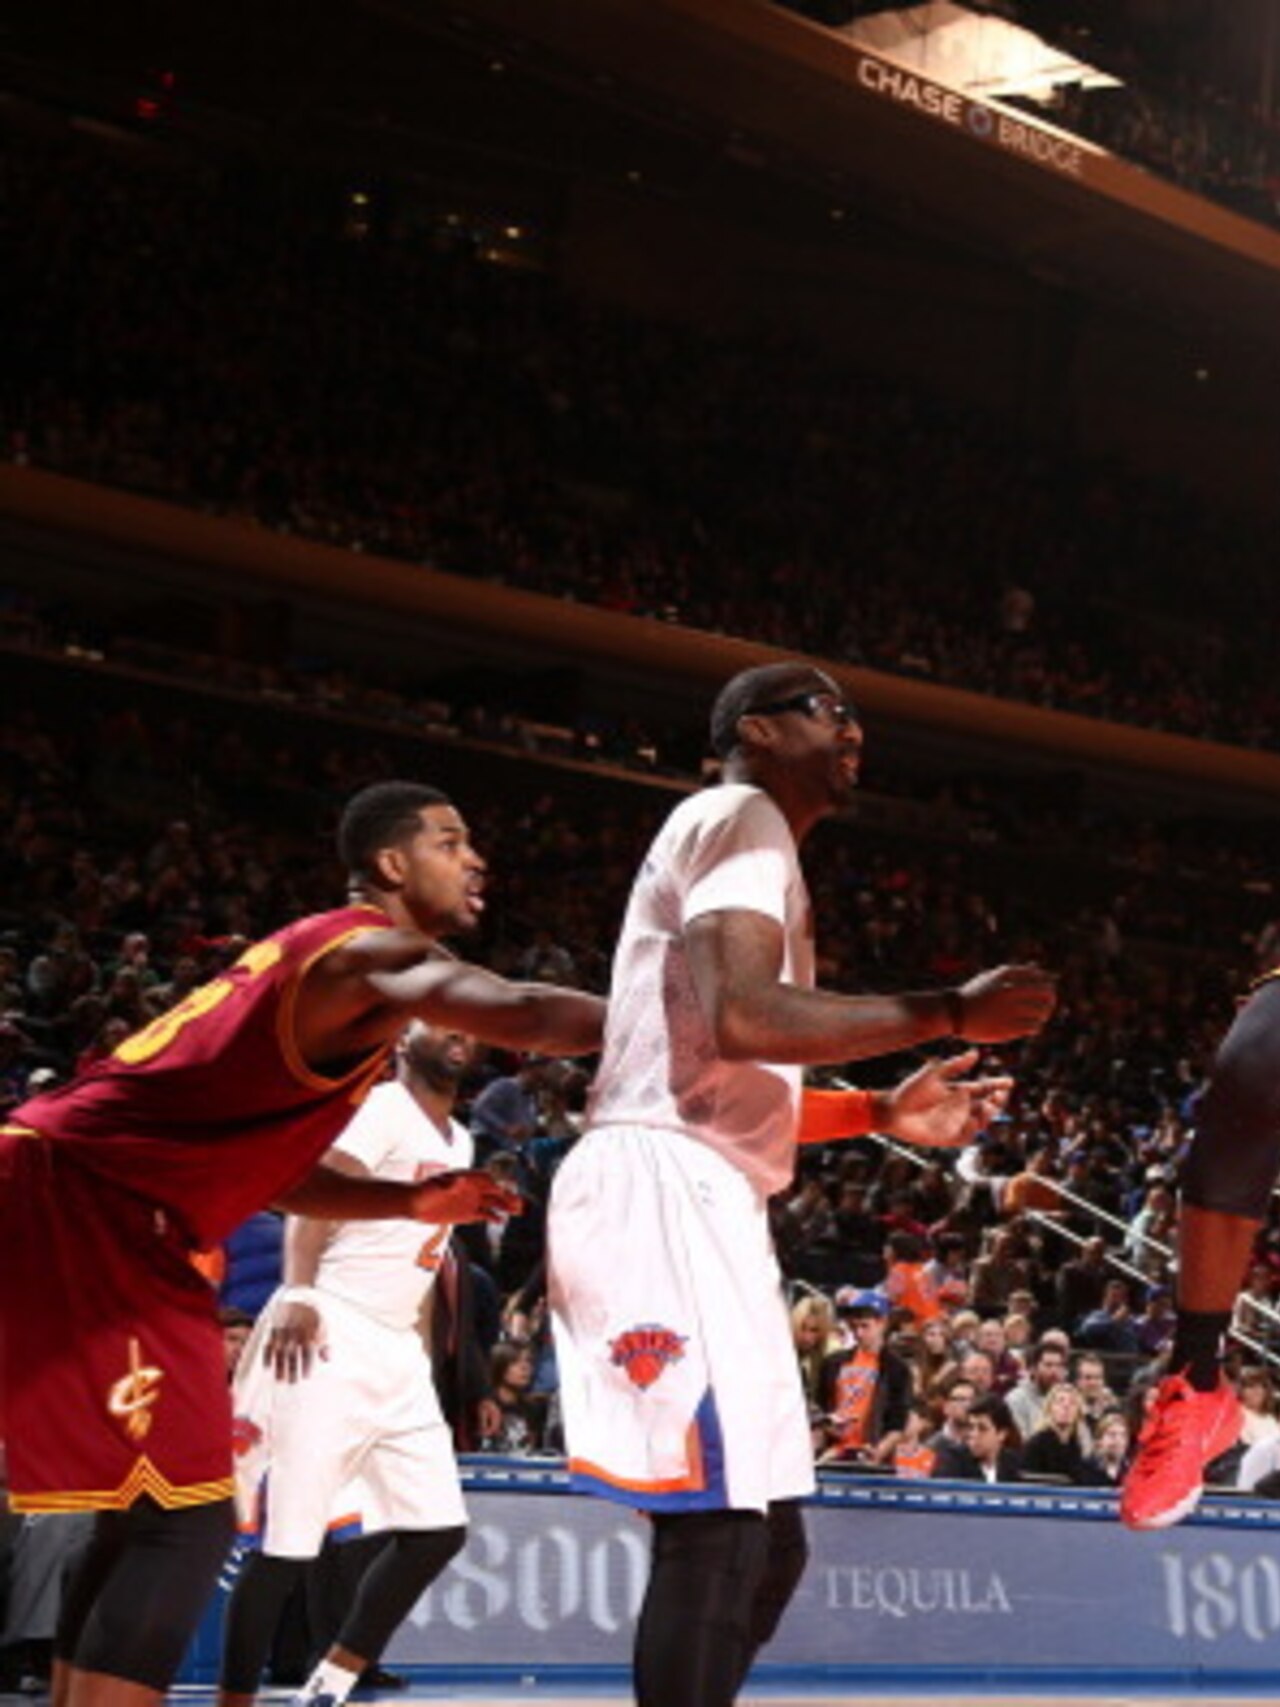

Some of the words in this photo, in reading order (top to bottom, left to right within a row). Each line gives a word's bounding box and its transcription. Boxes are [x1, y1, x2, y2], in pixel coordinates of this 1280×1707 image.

[856, 57, 964, 127] CHASE
[998, 113, 1084, 176] BRIDGE
[824, 1566, 1014, 1618] TEQUILA
